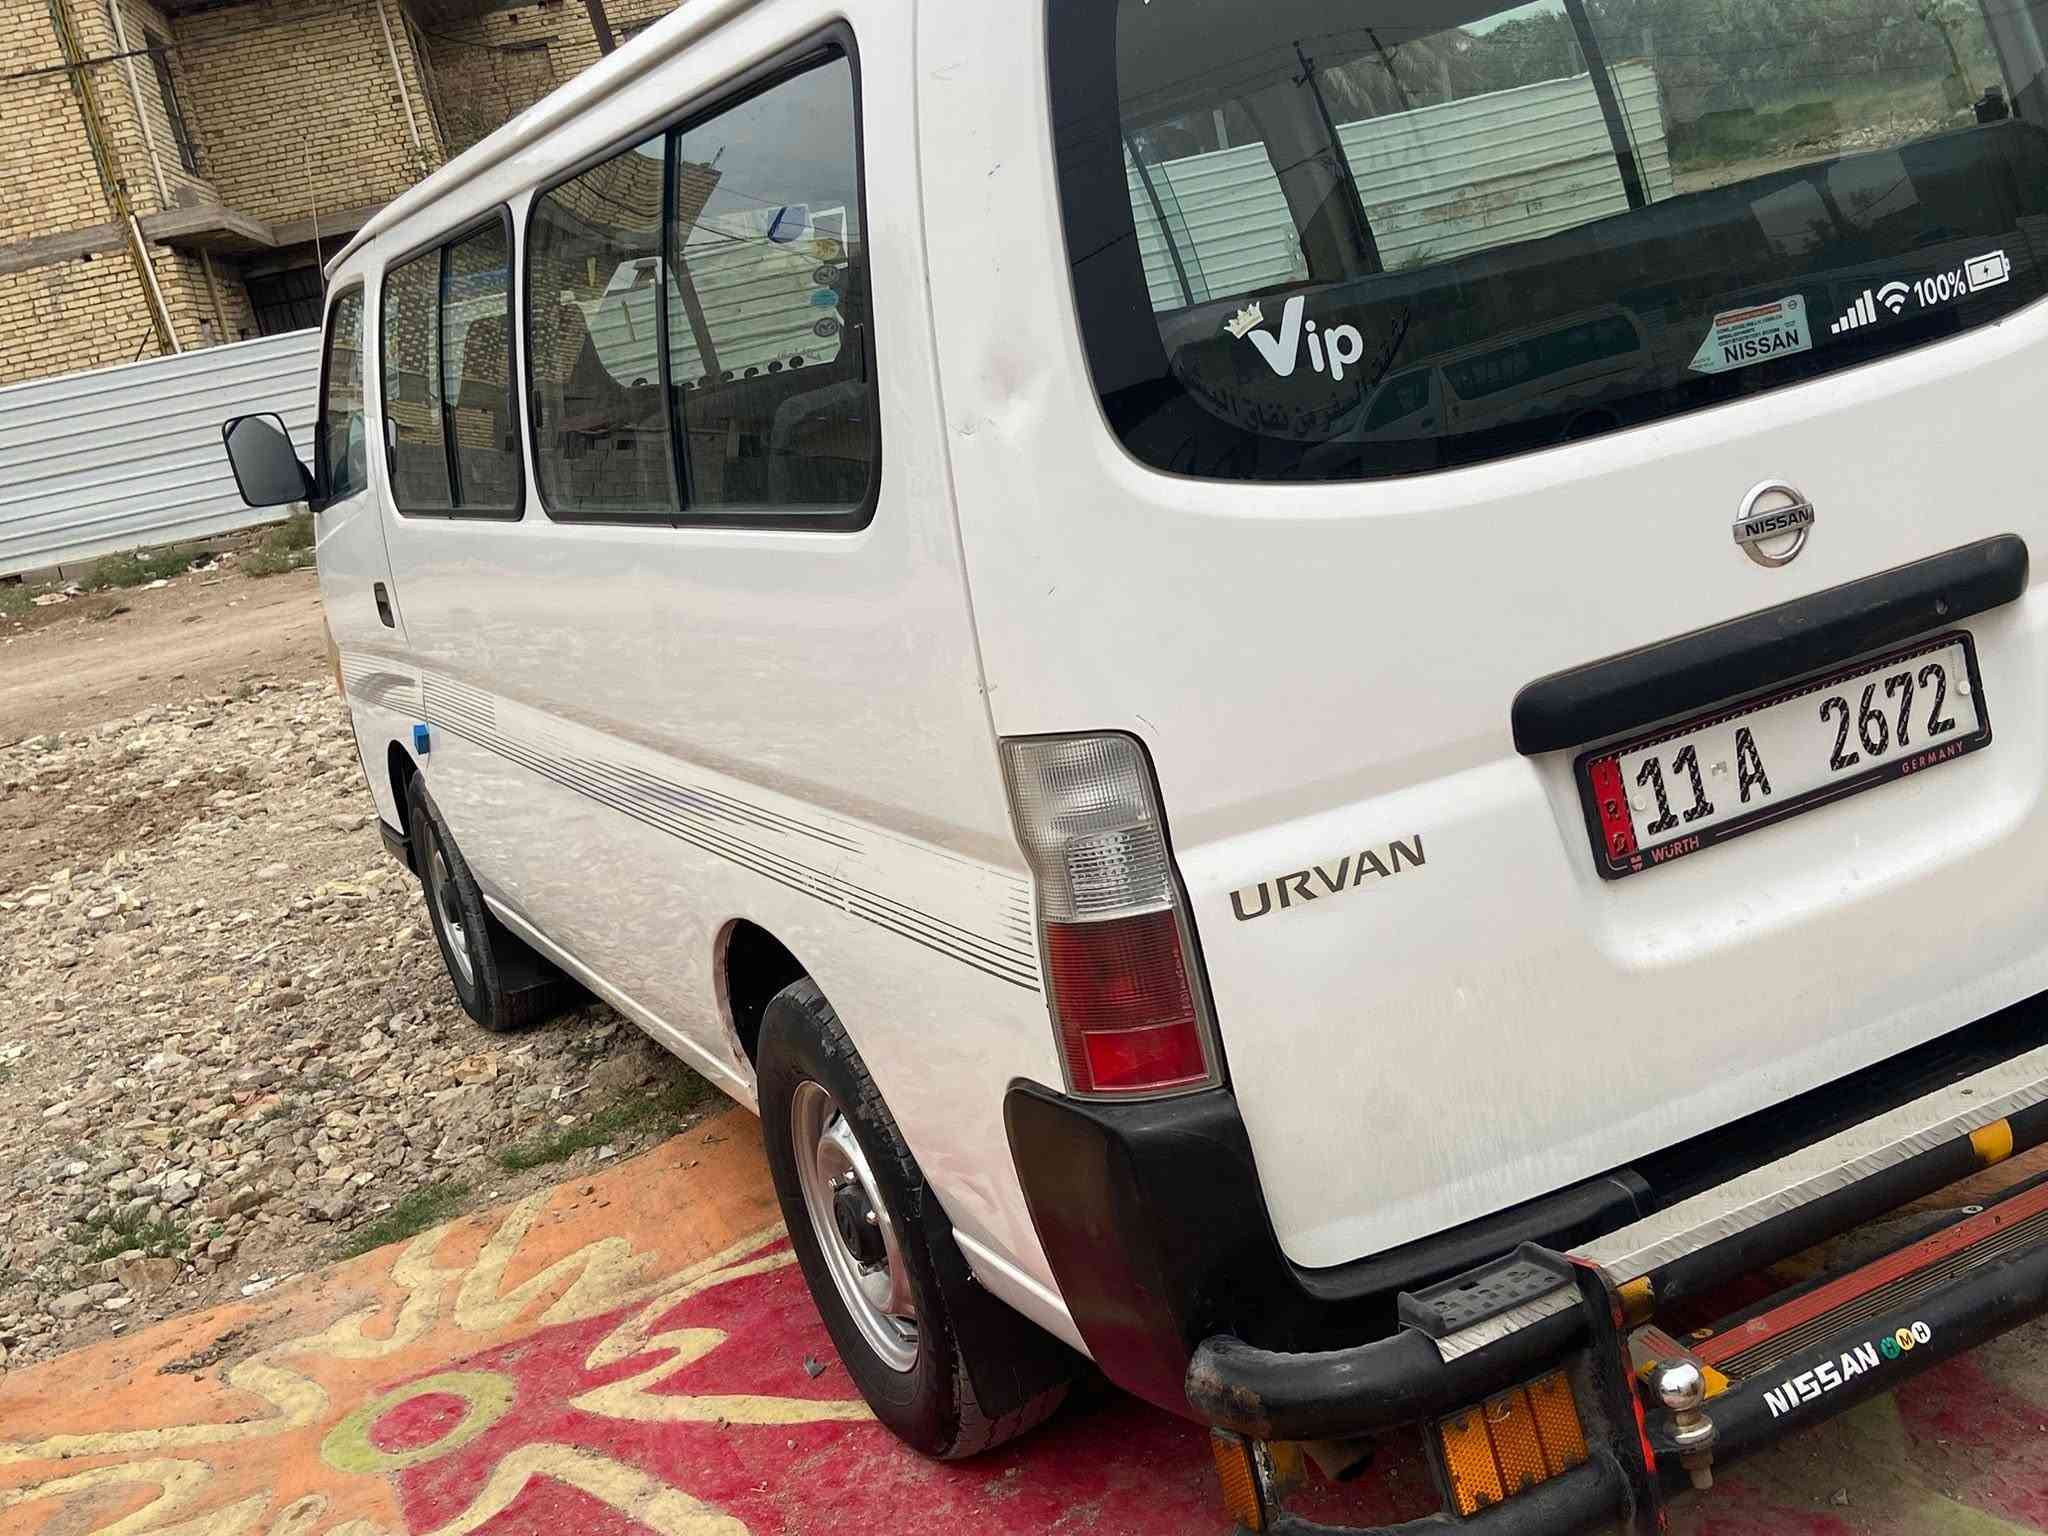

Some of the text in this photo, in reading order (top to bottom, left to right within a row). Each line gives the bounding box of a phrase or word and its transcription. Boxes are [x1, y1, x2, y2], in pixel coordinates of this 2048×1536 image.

[1913, 268, 1967, 307] 100%
[1247, 295, 1364, 381] Vip
[1723, 328, 1800, 364] NISSAN
[1745, 508, 1809, 536] NISSAN
[1636, 662, 1957, 835] 11 A 2672
[1901, 741, 1965, 776] GERMANY
[1229, 834, 1426, 922] URVAN
[1762, 1341, 1881, 1420] NISSAN
